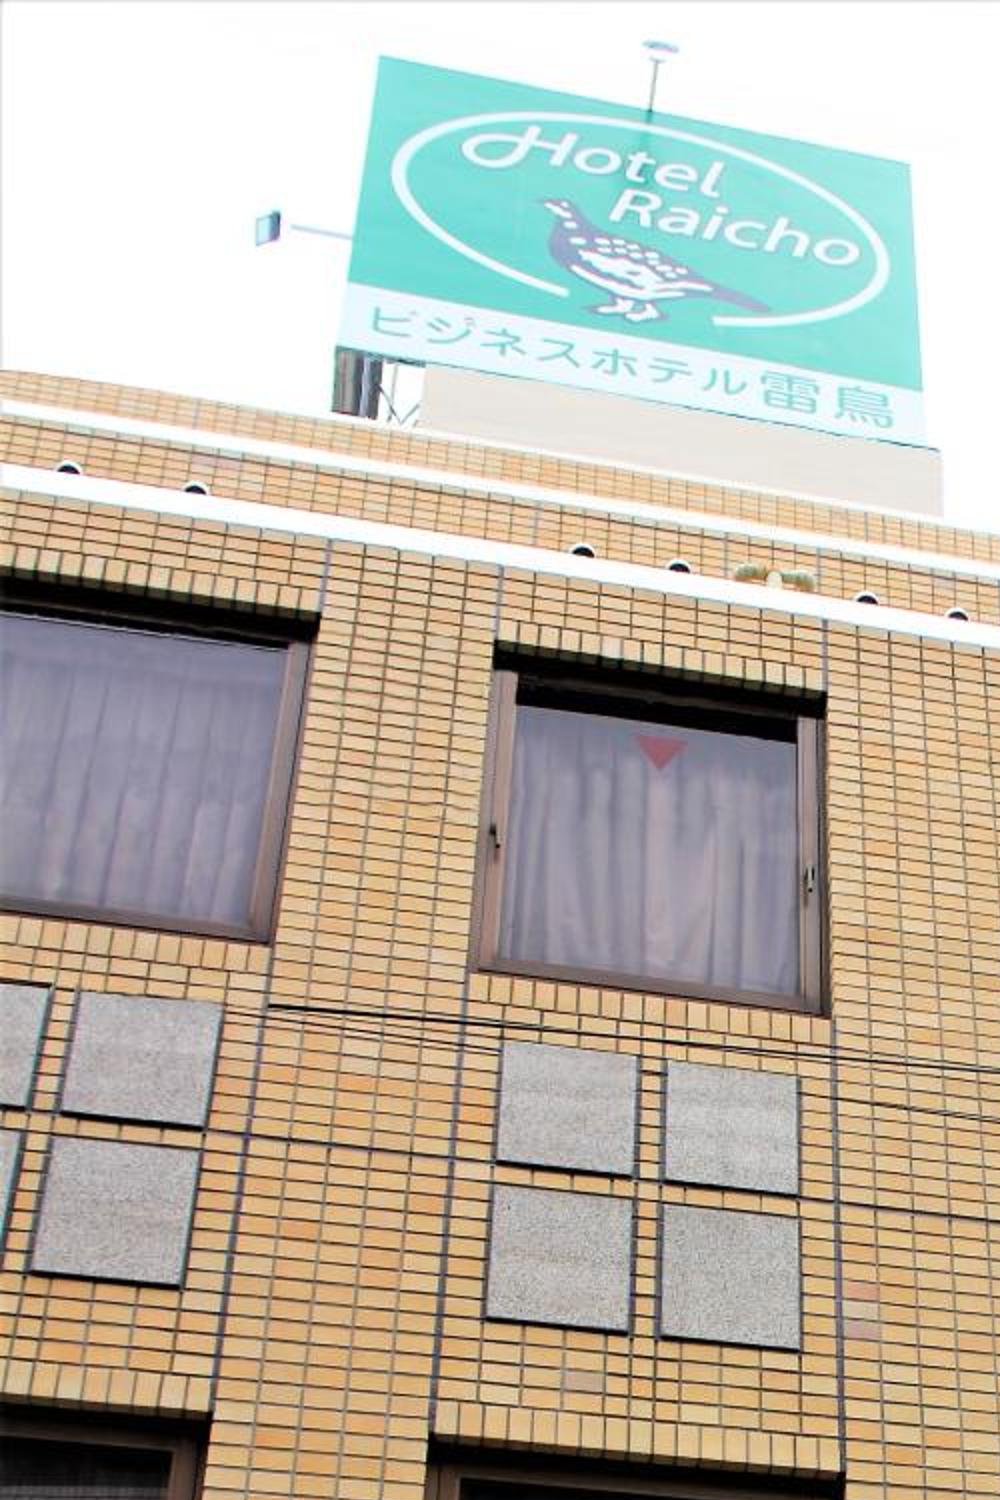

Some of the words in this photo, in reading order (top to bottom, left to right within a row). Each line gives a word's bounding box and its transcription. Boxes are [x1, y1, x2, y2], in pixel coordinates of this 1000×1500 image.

[461, 124, 725, 200] Hotel
[607, 188, 862, 268] Raicho
[370, 304, 895, 431] ビジネスホテル雷鳥
